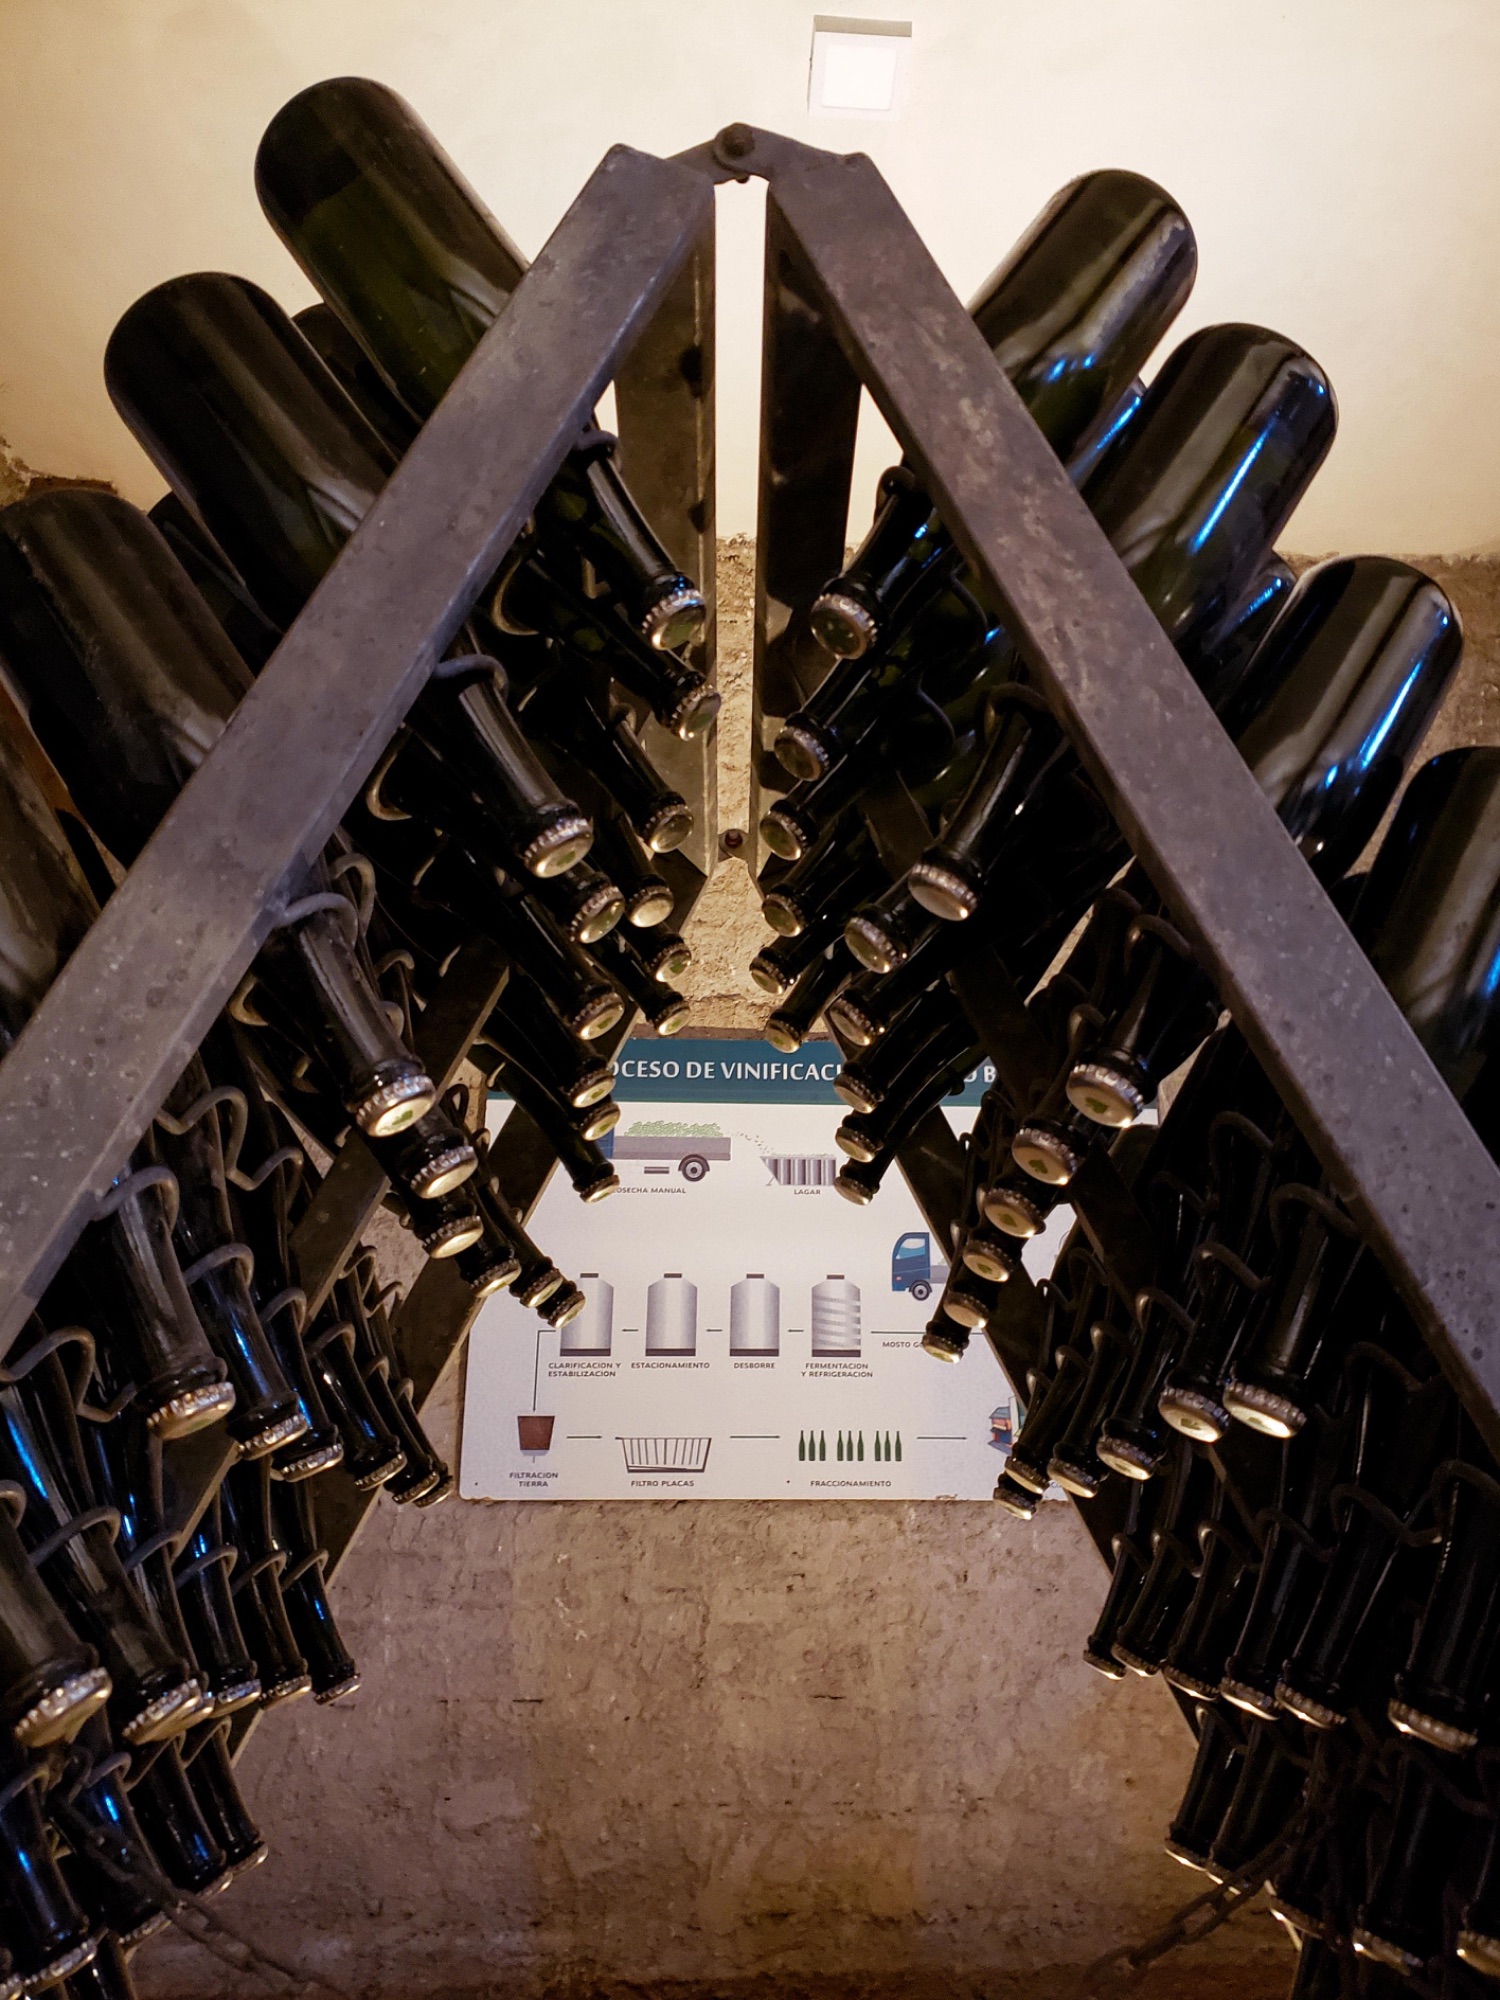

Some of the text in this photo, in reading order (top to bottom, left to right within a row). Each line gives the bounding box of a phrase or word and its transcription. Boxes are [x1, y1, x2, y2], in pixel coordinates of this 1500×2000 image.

[686, 1061, 715, 1079] DE
[615, 1186, 687, 1194] OSECHA MANUAL
[805, 1362, 869, 1370] FERMENTACION
